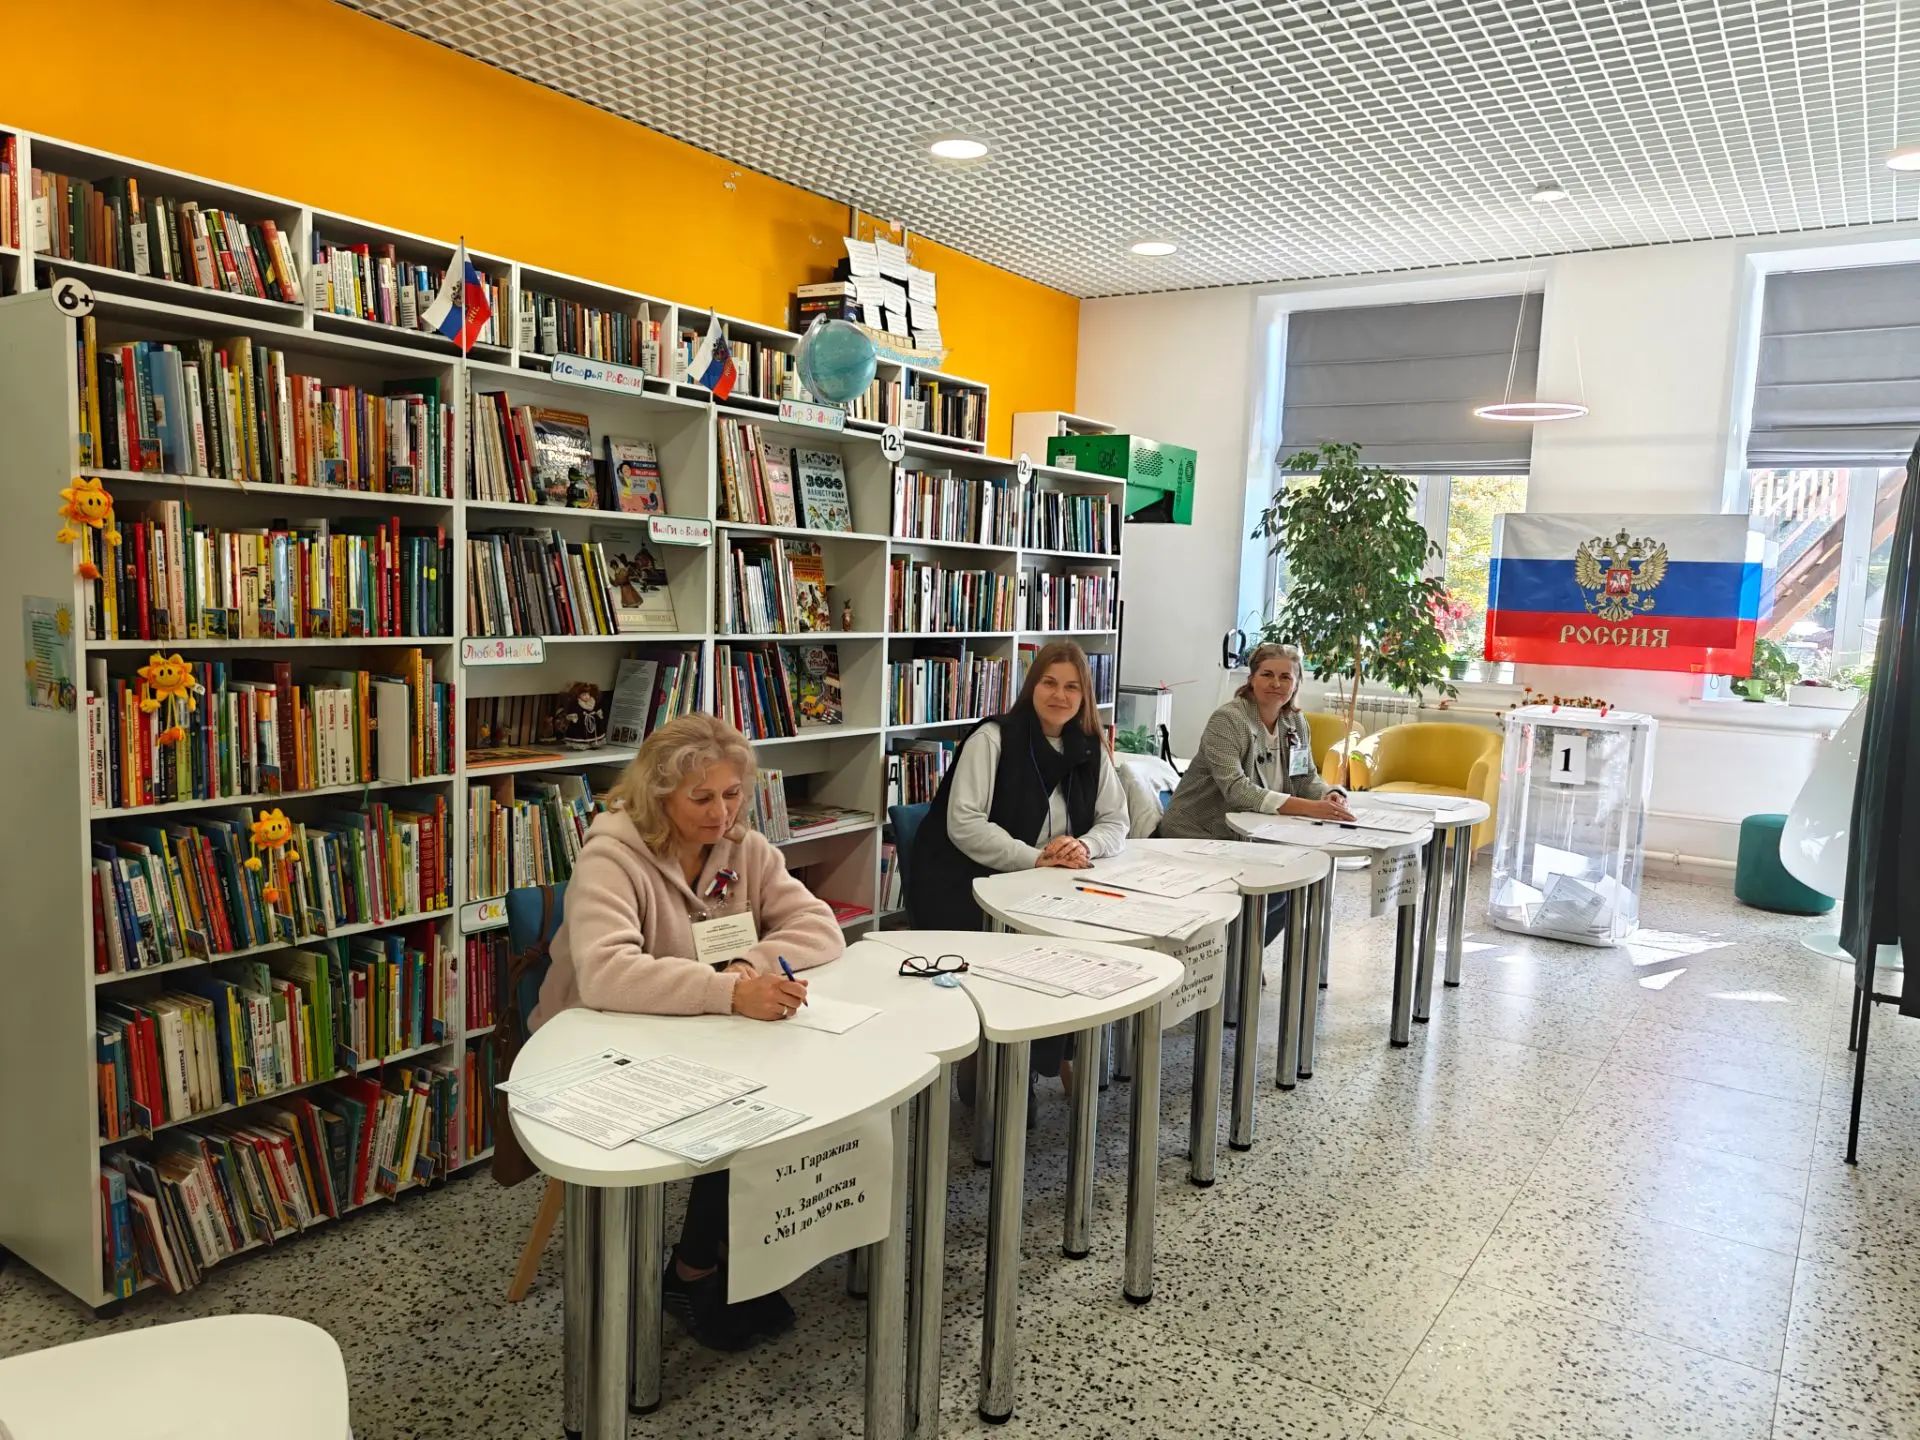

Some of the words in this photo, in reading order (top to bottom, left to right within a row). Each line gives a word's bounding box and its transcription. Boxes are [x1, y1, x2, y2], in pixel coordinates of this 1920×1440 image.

[57, 284, 95, 311] 6+
[208, 387, 218, 427] БИАНКИ
[781, 403, 804, 423] Мир
[806, 408, 844, 427] Знаний
[880, 434, 906, 451] 12+
[1018, 460, 1032, 476] 12+
[805, 474, 844, 491] 3000
[1018, 579, 1027, 597] Н
[1559, 624, 1670, 649] РОССИЯ
[916, 666, 923, 685] Г
[1560, 747, 1572, 772] 1
[888, 763, 898, 785] Д
[775, 1165, 797, 1182] ул.
[800, 1138, 860, 1171] Гаражная
[814, 1172, 823, 1184] и
[774, 1207, 796, 1224] ул.
[798, 1176, 857, 1212] Заводская
[763, 1232, 772, 1245] с
[774, 1222, 796, 1242] №1
[799, 1217, 813, 1233] до
[814, 1201, 833, 1223] №9
[834, 1199, 855, 1212] кв.
[857, 1190, 866, 1204] 6
